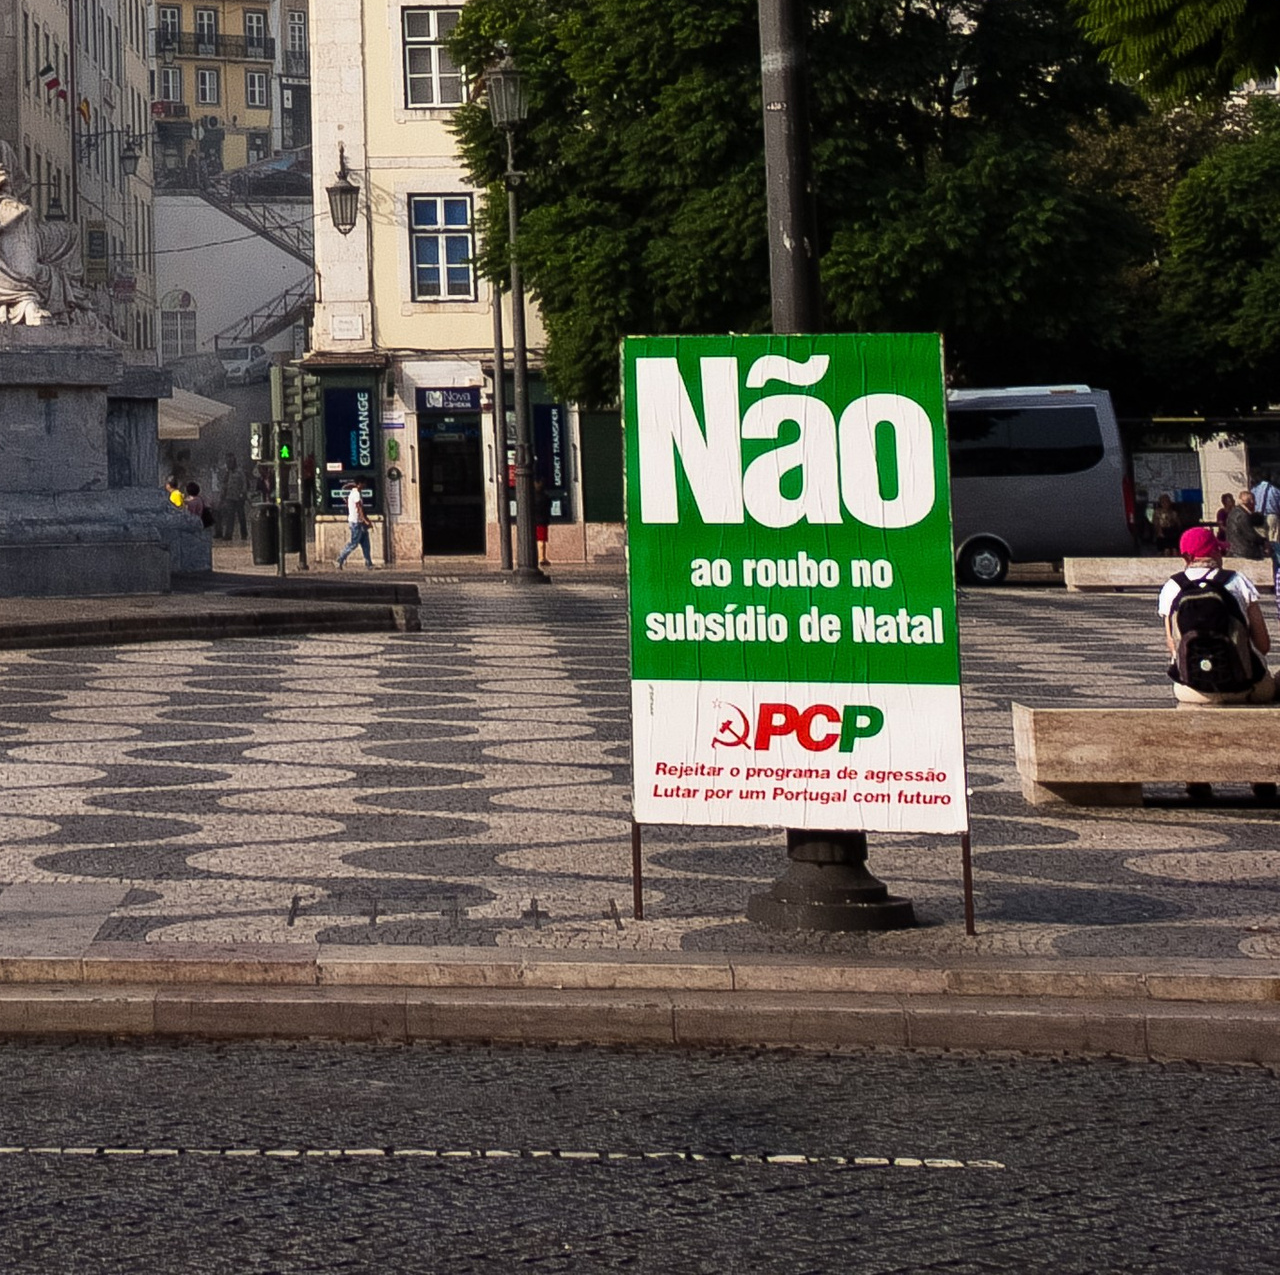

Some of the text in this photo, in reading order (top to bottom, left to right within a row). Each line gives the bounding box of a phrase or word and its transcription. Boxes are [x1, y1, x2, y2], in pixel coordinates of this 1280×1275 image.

[443, 390, 471, 401] Nova
[357, 392, 371, 466] EXCHANGE
[635, 354, 936, 529] Não
[691, 551, 894, 589] ao roubo no
[645, 603, 945, 645] subsídio de Natal
[754, 702, 885, 753] PCP
[654, 762, 947, 784] Rejeitar o programa de agressão
[652, 784, 952, 806] Lutar por um Portugal com futuro
